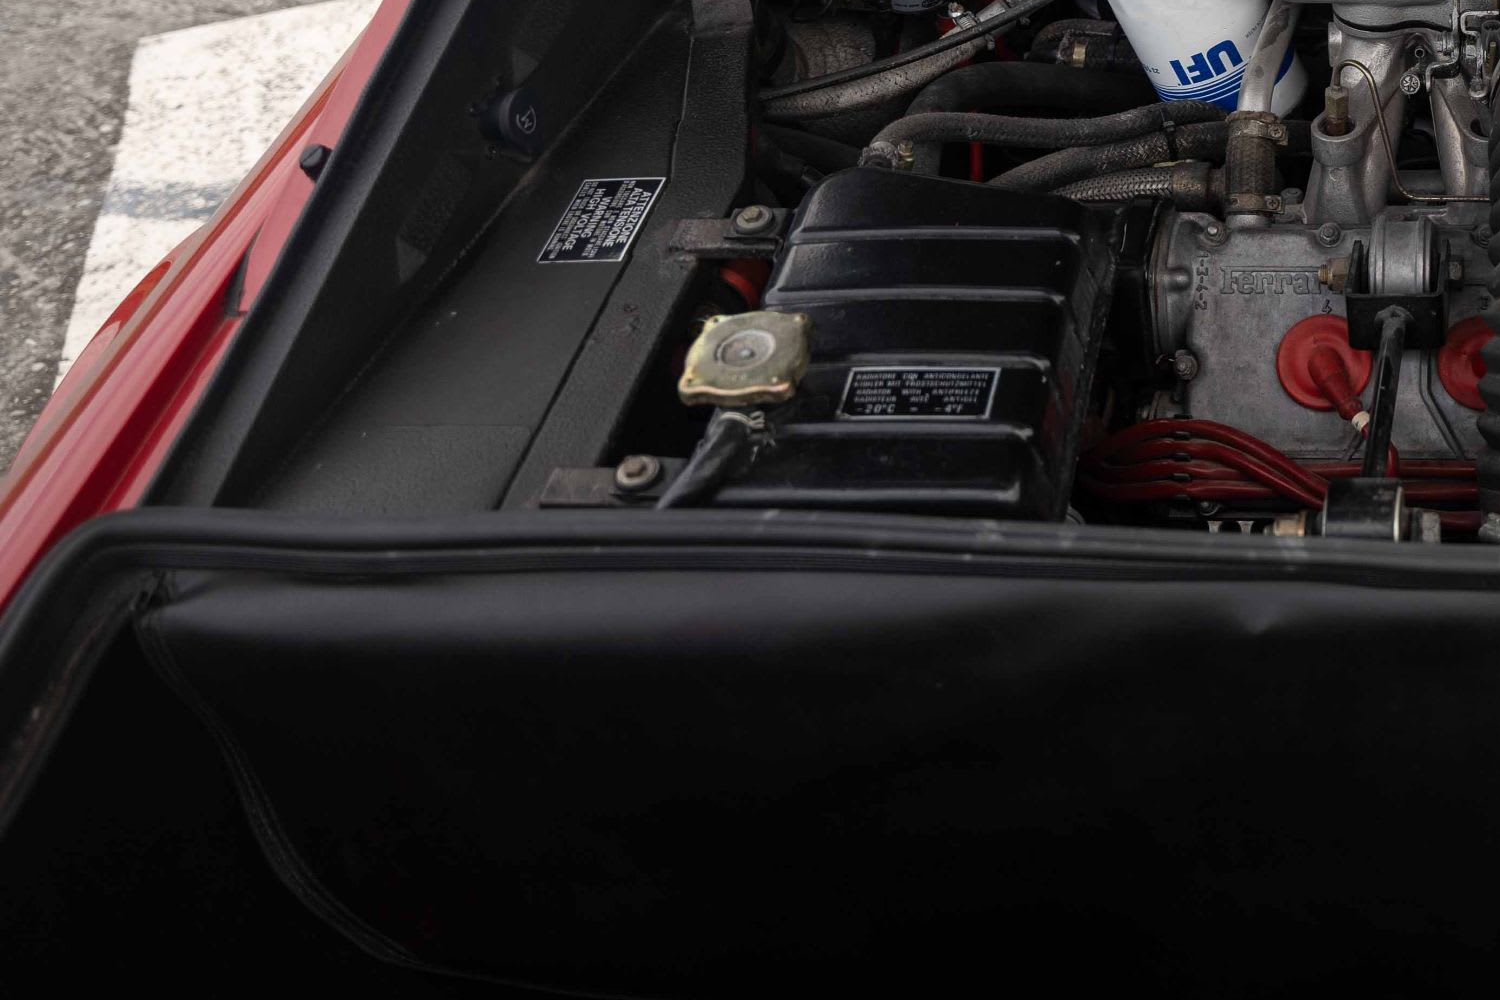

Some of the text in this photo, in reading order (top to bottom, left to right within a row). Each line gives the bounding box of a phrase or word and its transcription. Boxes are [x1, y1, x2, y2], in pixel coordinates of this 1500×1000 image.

[1169, 39, 1243, 86] UFI
[561, 188, 606, 250] HIGH VOLTAGE
[579, 196, 612, 237] WARNING
[600, 187, 644, 247] ALTA TENSIONE
[614, 191, 653, 243] ATTENZIONE
